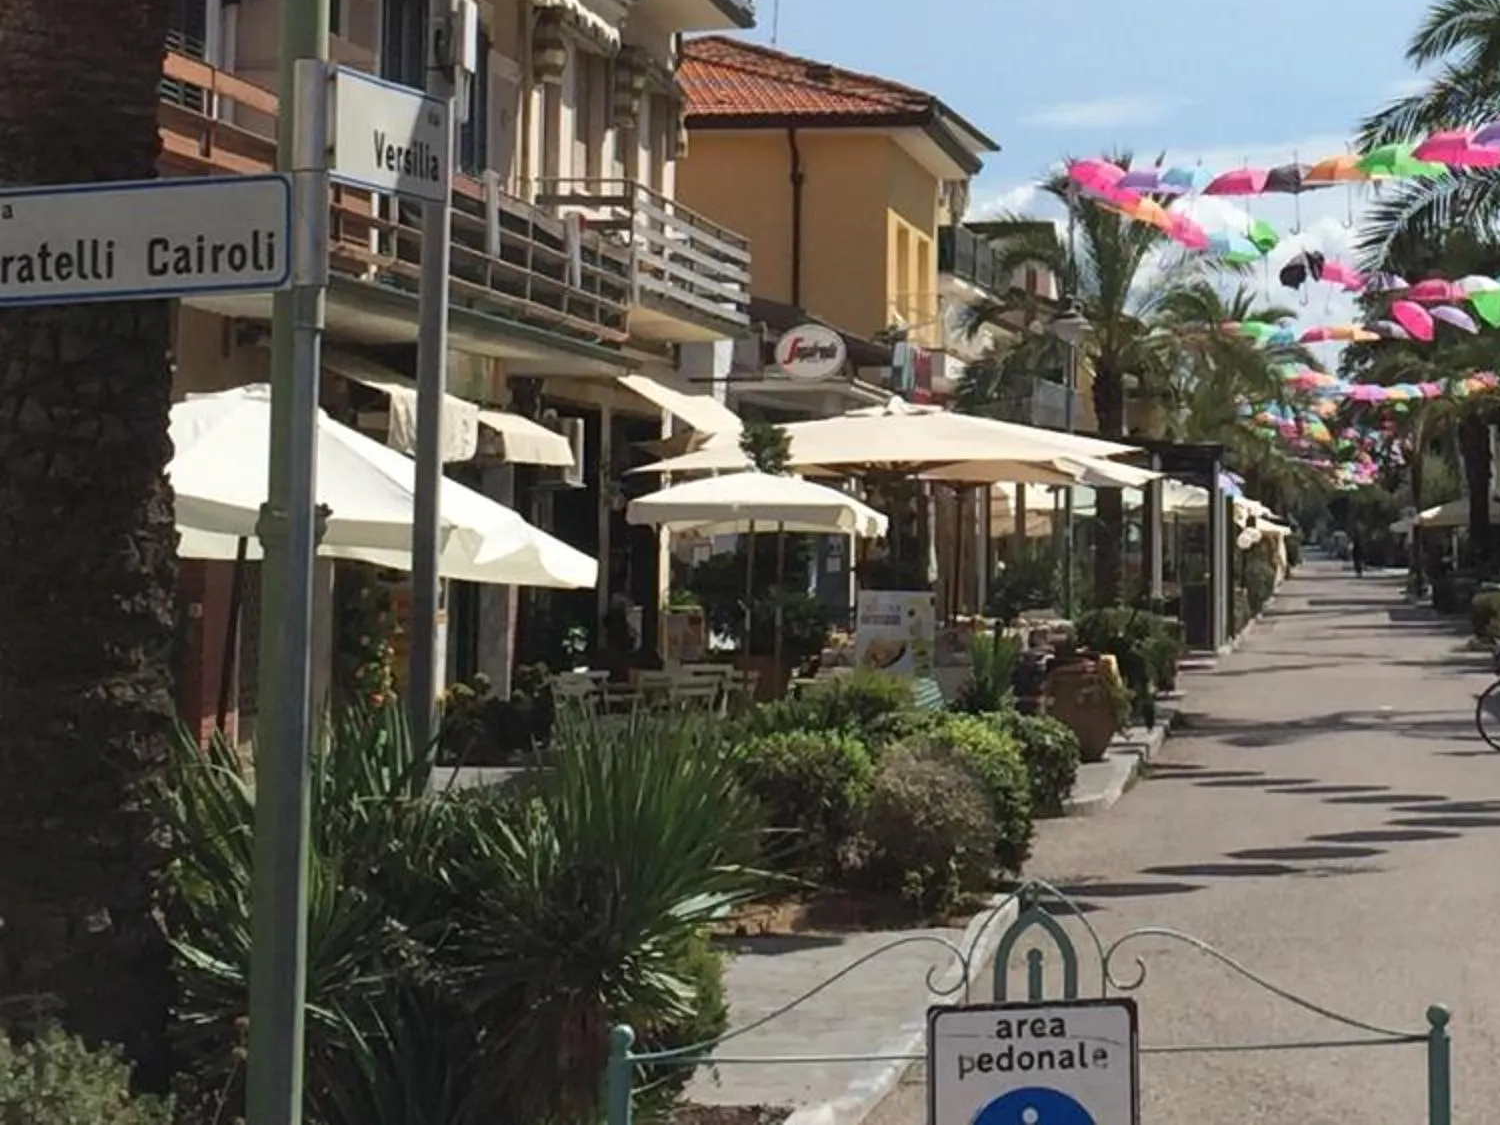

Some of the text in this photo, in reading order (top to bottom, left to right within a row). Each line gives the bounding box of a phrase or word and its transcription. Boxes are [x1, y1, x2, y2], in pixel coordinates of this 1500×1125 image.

[373, 127, 440, 182] Versilia
[1, 230, 276, 284] ratelli Cairoli
[995, 1016, 1066, 1039] area
[958, 1042, 1109, 1080] pedonale
